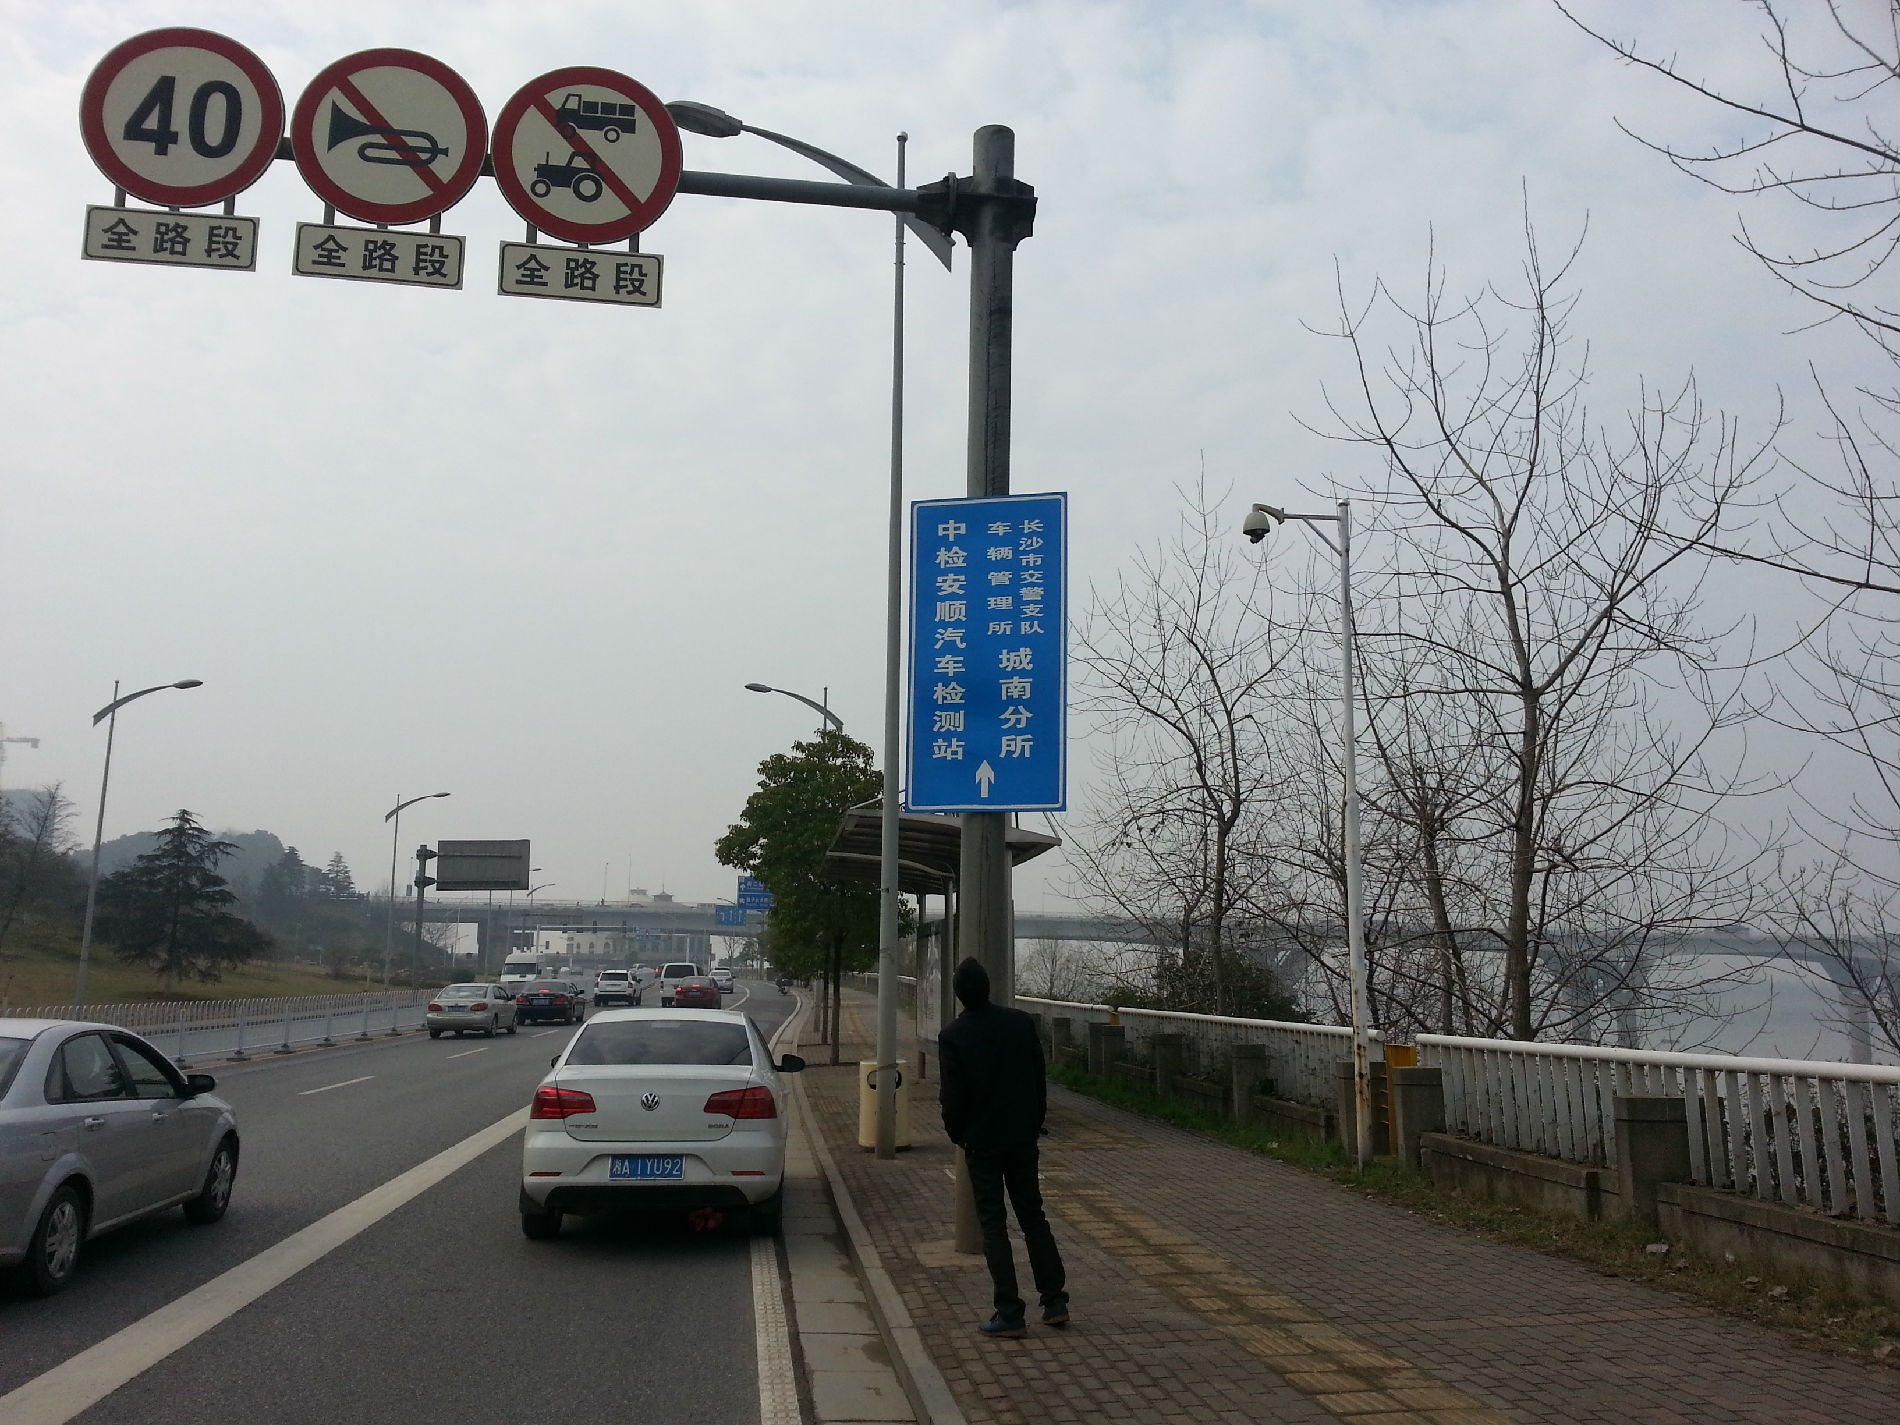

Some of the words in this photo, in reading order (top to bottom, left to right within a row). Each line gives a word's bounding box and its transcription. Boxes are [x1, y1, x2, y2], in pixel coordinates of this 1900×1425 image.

[122, 74, 243, 159] 40
[101, 216, 243, 260] 全路段
[311, 234, 450, 279] 全路段
[515, 252, 649, 298] 全路段
[986, 521, 1013, 635] 车辆管理所
[1018, 519, 1044, 634] 长沙市交警支队
[932, 519, 967, 760] 中检安顺汽车检测站
[998, 647, 1033, 758] 城南分所
